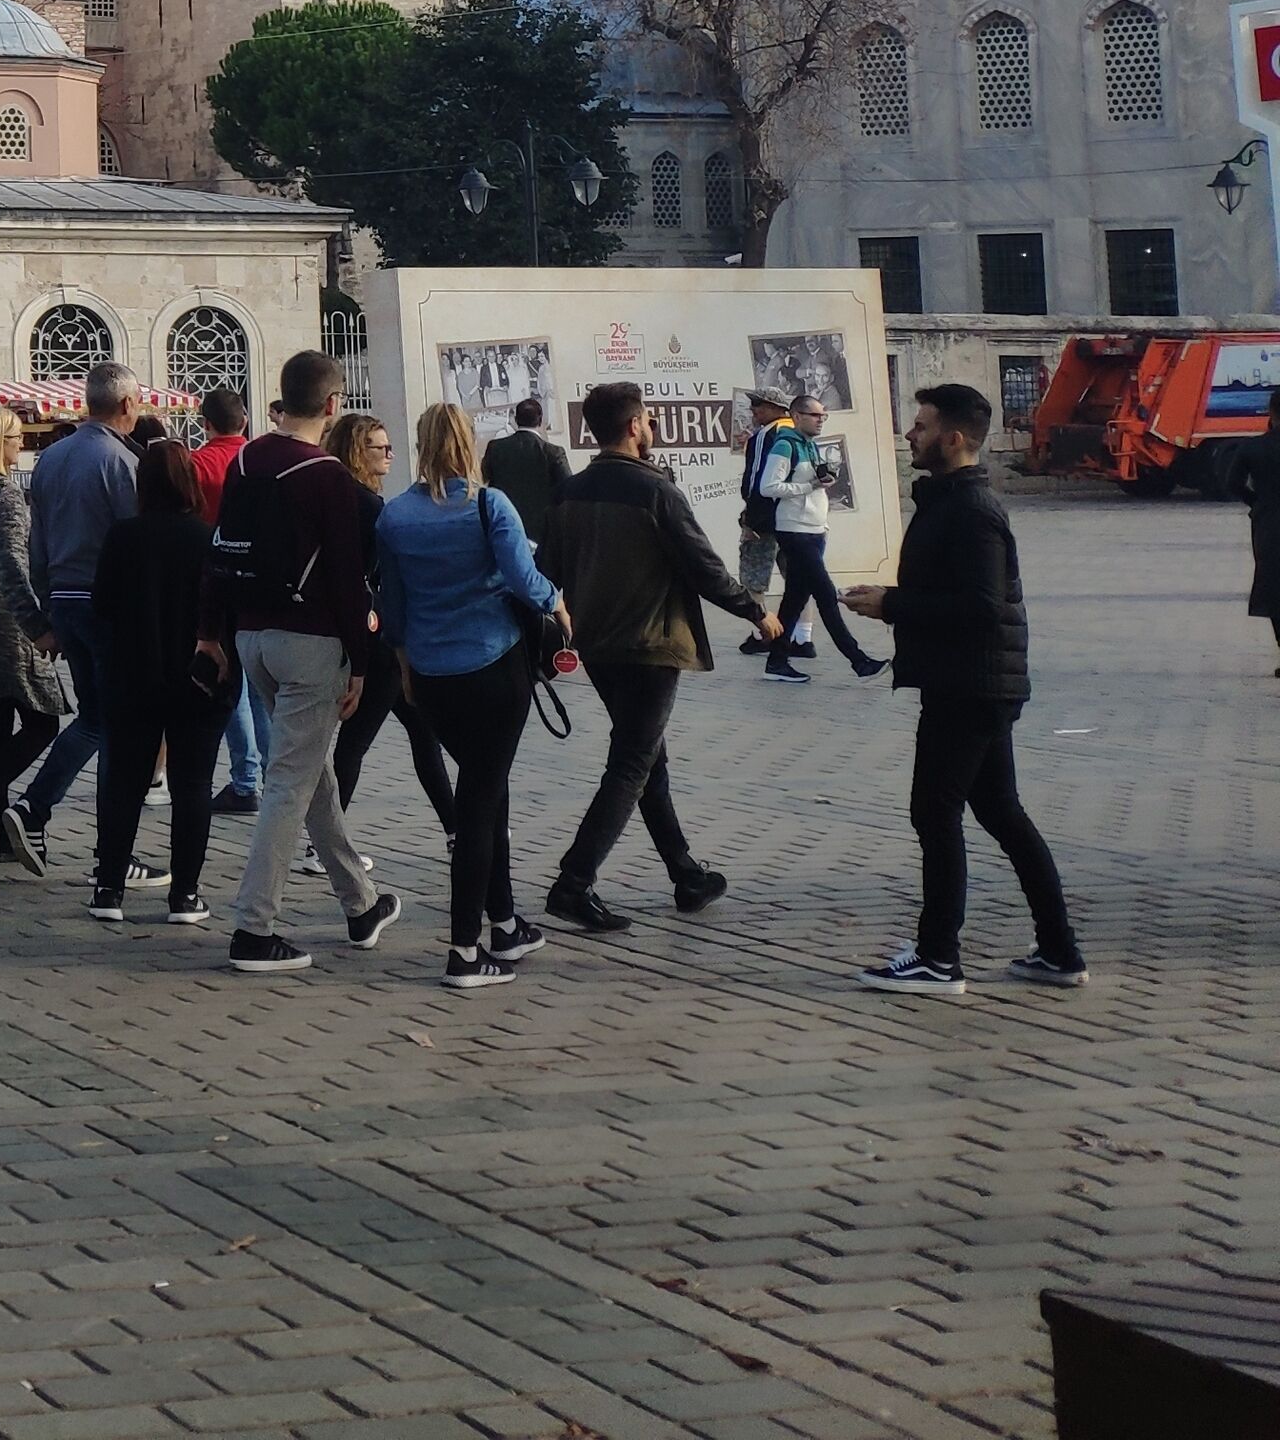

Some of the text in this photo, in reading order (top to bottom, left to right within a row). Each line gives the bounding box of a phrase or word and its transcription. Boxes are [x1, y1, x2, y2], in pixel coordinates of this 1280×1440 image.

[610, 322, 628, 339] 29
[693, 382, 718, 396] VE
[694, 494, 702, 502] 17
[704, 489, 727, 500] KASIM
